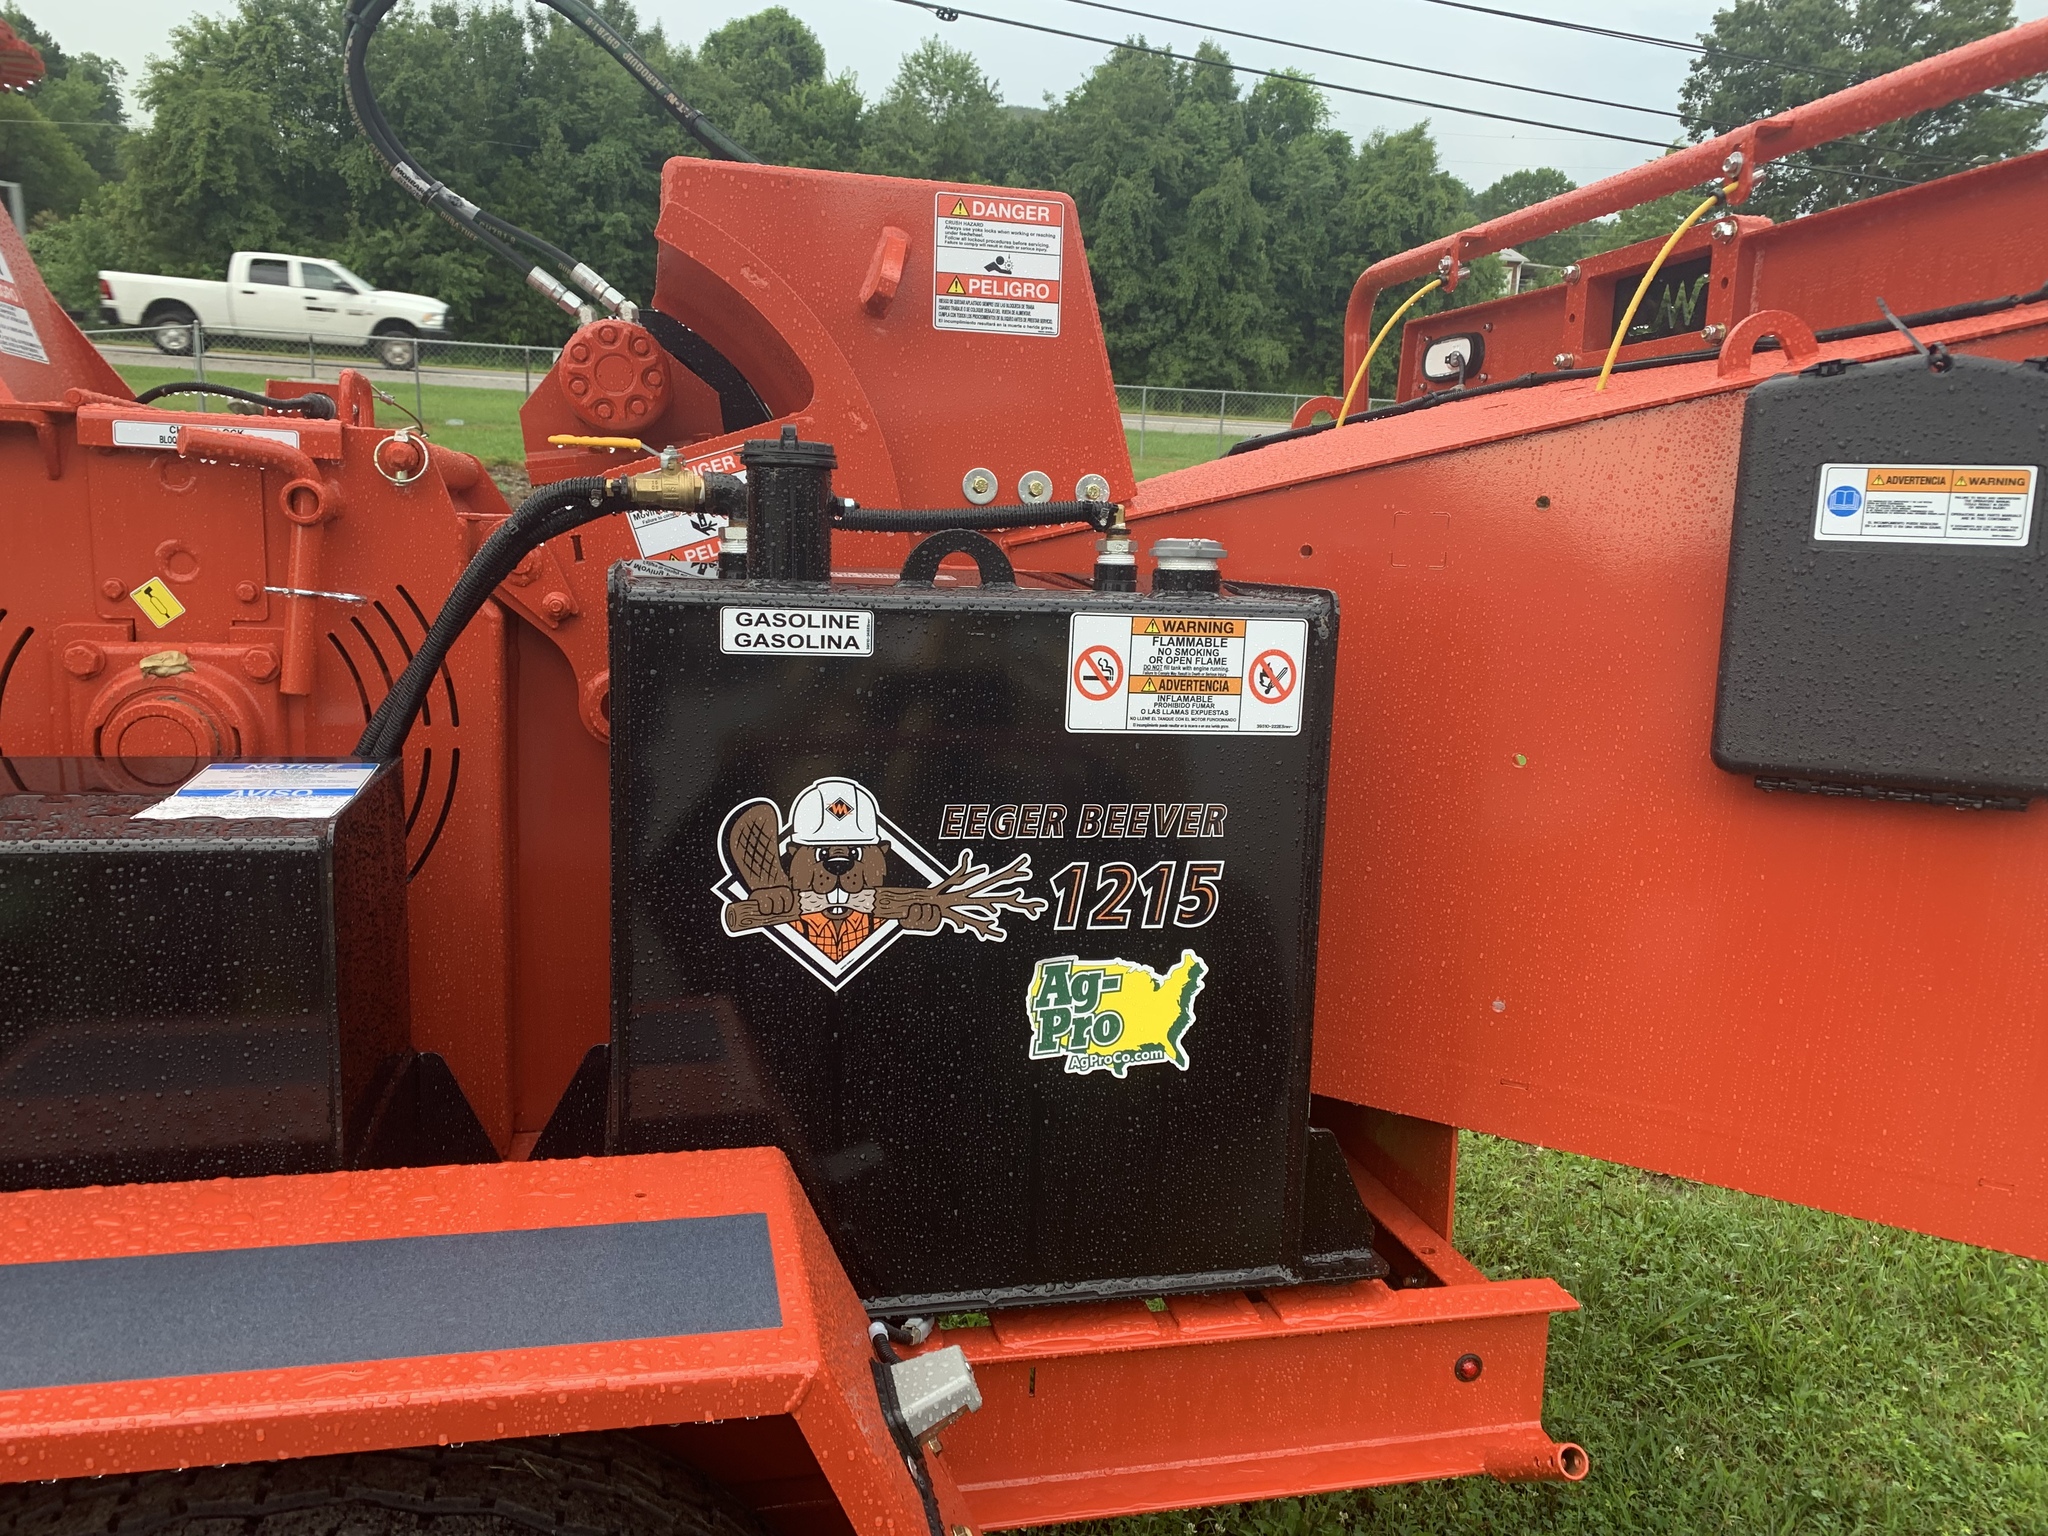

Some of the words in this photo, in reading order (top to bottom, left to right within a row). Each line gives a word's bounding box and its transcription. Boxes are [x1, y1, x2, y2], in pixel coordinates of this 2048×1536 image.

[623, 52, 664, 90] AEROQUIP
[395, 167, 424, 193] MORBAR
[972, 201, 1050, 221] DANGER
[968, 279, 1050, 299] PELIGRO
[1886, 476, 1946, 486] ADVERTENCIA
[1969, 478, 2026, 486] WARNING
[642, 517, 658, 525] Failure
[736, 612, 860, 630] GASOLINE
[1163, 621, 1234, 633] WARNING
[734, 633, 860, 650] GASOLINA
[1153, 637, 1228, 647] FLAMMABLE
[1175, 648, 1219, 656] SMOKING
[1149, 656, 1163, 664] OR
[1166, 657, 1192, 665] OPEN
[1195, 658, 1227, 666] FLAME
[1159, 679, 1229, 692] ADVERTENCIA
[223, 789, 313, 797] AVISO
[939, 804, 1068, 839] EEGER
[1076, 803, 1228, 838] BEEVER
[1050, 861, 1225, 930] 1215
[1033, 959, 1124, 1015] Ag-
[1032, 1006, 1124, 1056] Pro
[1069, 1047, 1165, 1072] AgProCo.com
